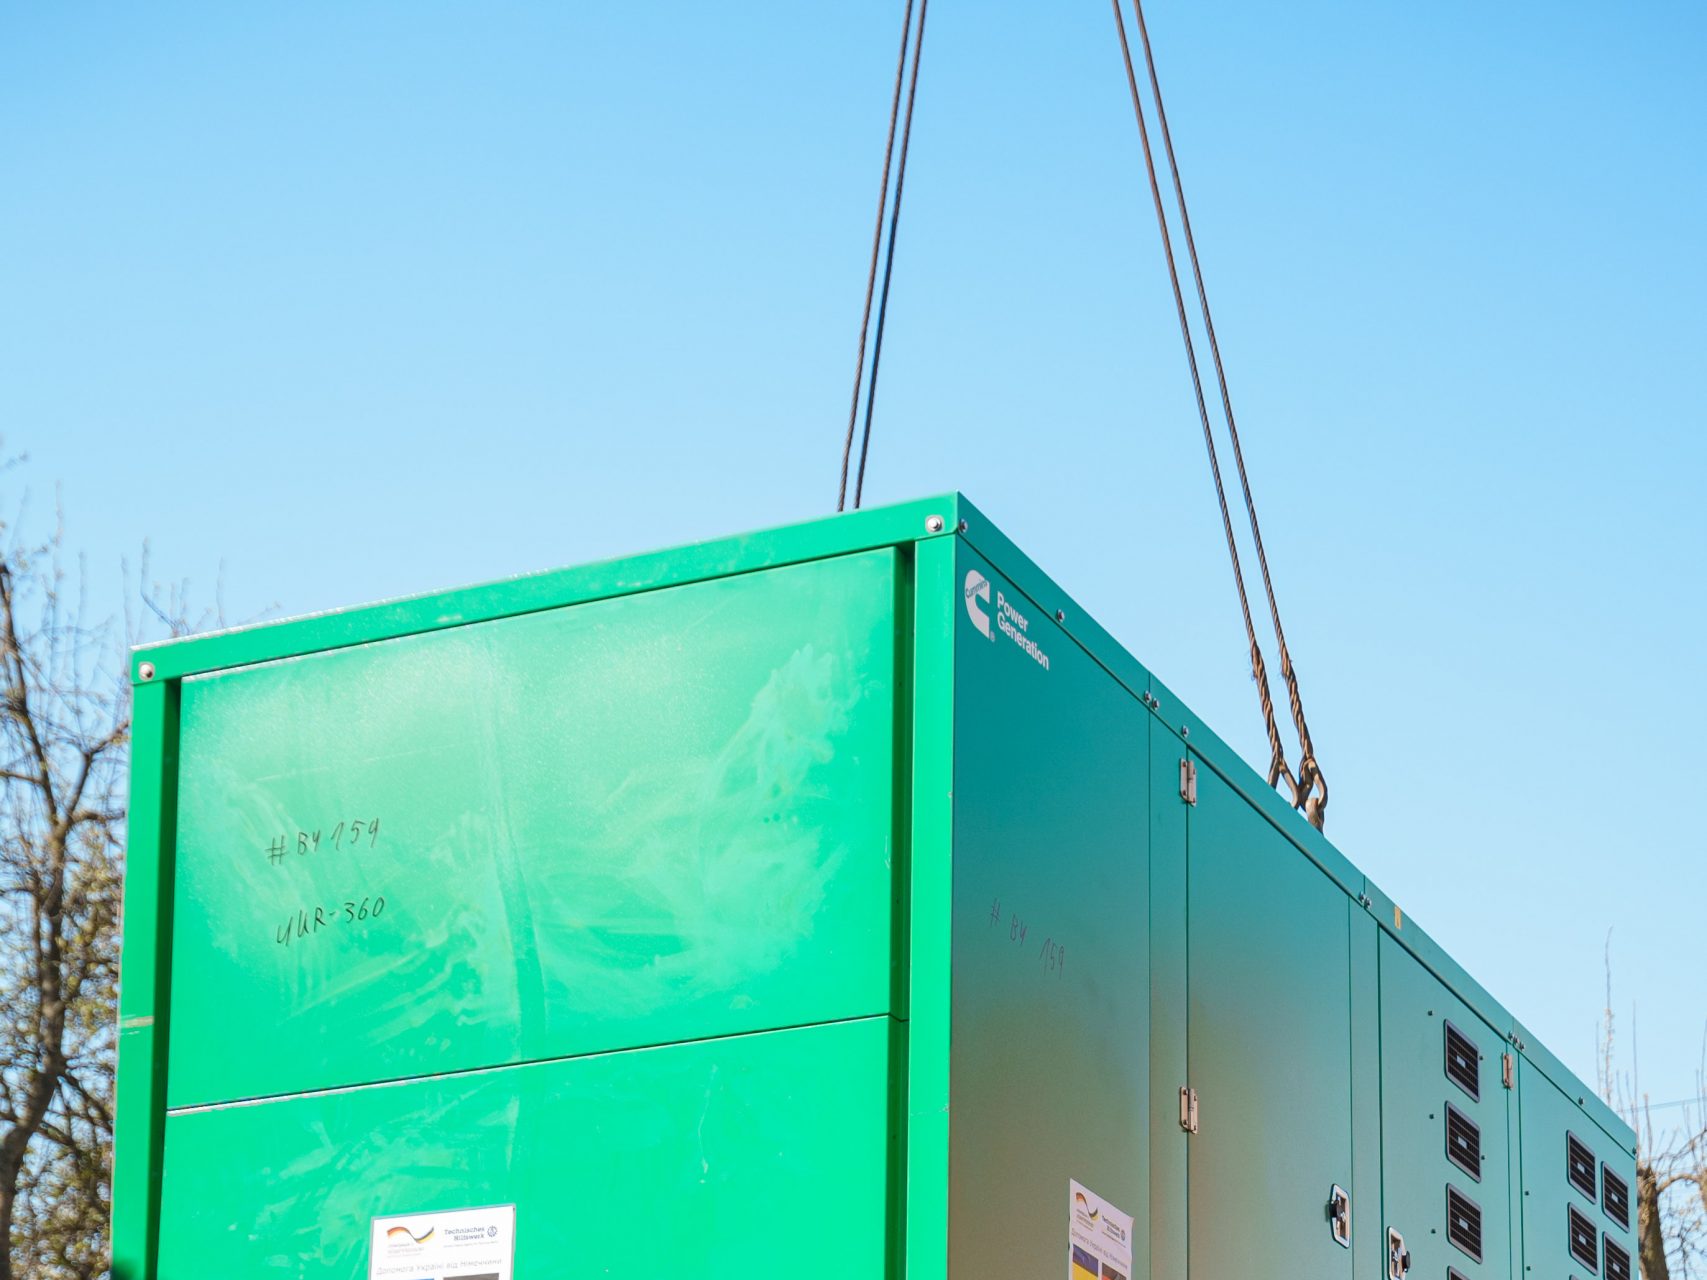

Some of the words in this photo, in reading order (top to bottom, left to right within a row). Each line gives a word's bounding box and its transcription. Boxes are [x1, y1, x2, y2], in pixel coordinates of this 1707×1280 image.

[997, 591, 1029, 632] Power
[997, 611, 1050, 671] Generation
[444, 1226, 486, 1235] Technisches
